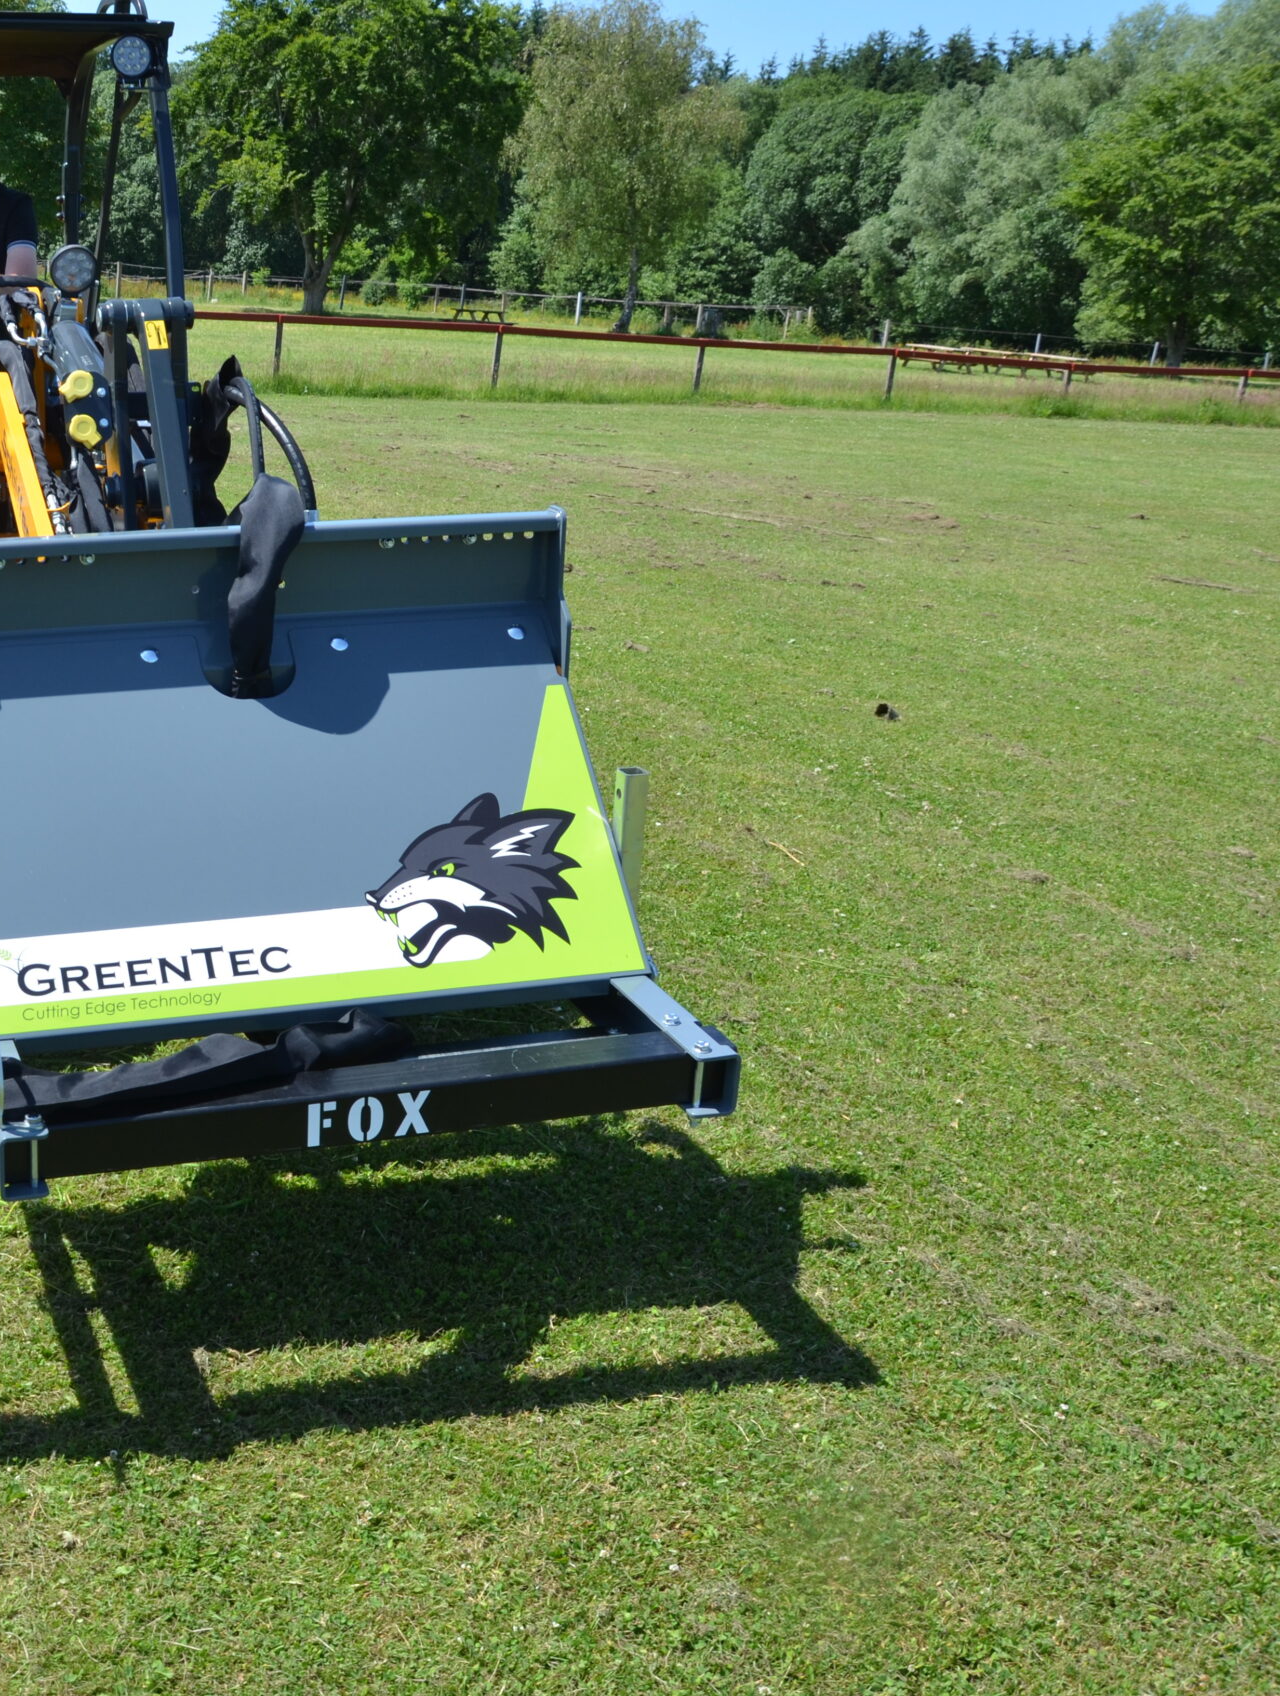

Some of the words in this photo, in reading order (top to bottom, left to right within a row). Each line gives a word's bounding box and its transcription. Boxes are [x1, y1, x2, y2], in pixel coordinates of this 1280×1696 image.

[22, 1004, 80, 1021] Cutting
[86, 999, 126, 1016] Edge
[131, 991, 222, 1010] Technology
[307, 1090, 431, 1148] FOX
